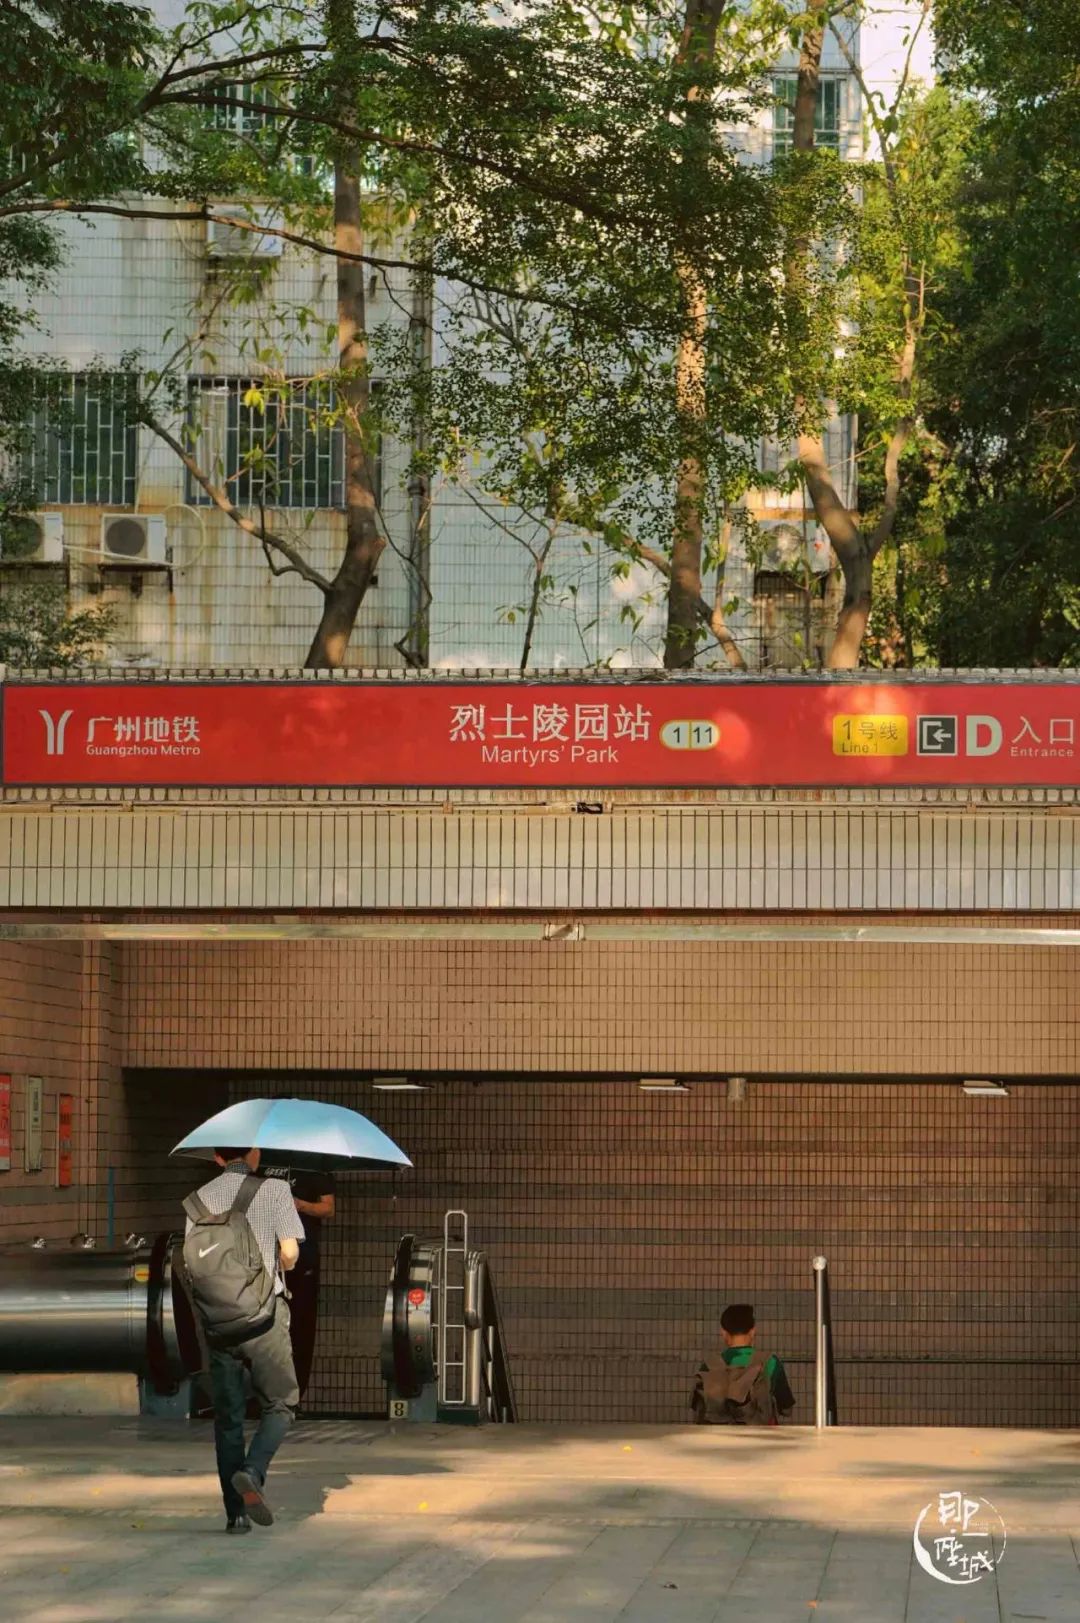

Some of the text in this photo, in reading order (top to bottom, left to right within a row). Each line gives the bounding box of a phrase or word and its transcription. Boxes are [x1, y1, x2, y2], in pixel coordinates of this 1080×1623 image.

[86, 716, 201, 742] 广州地铁
[449, 703, 652, 742] 烈士陵园站
[842, 720, 898, 741] 1号线
[1012, 716, 1074, 745] 入口
[966, 715, 1003, 756] D
[86, 744, 201, 757] Guangzhou Metro
[571, 746, 619, 763] Park
[842, 742, 869, 753] Line
[1010, 747, 1074, 757] Entrance
